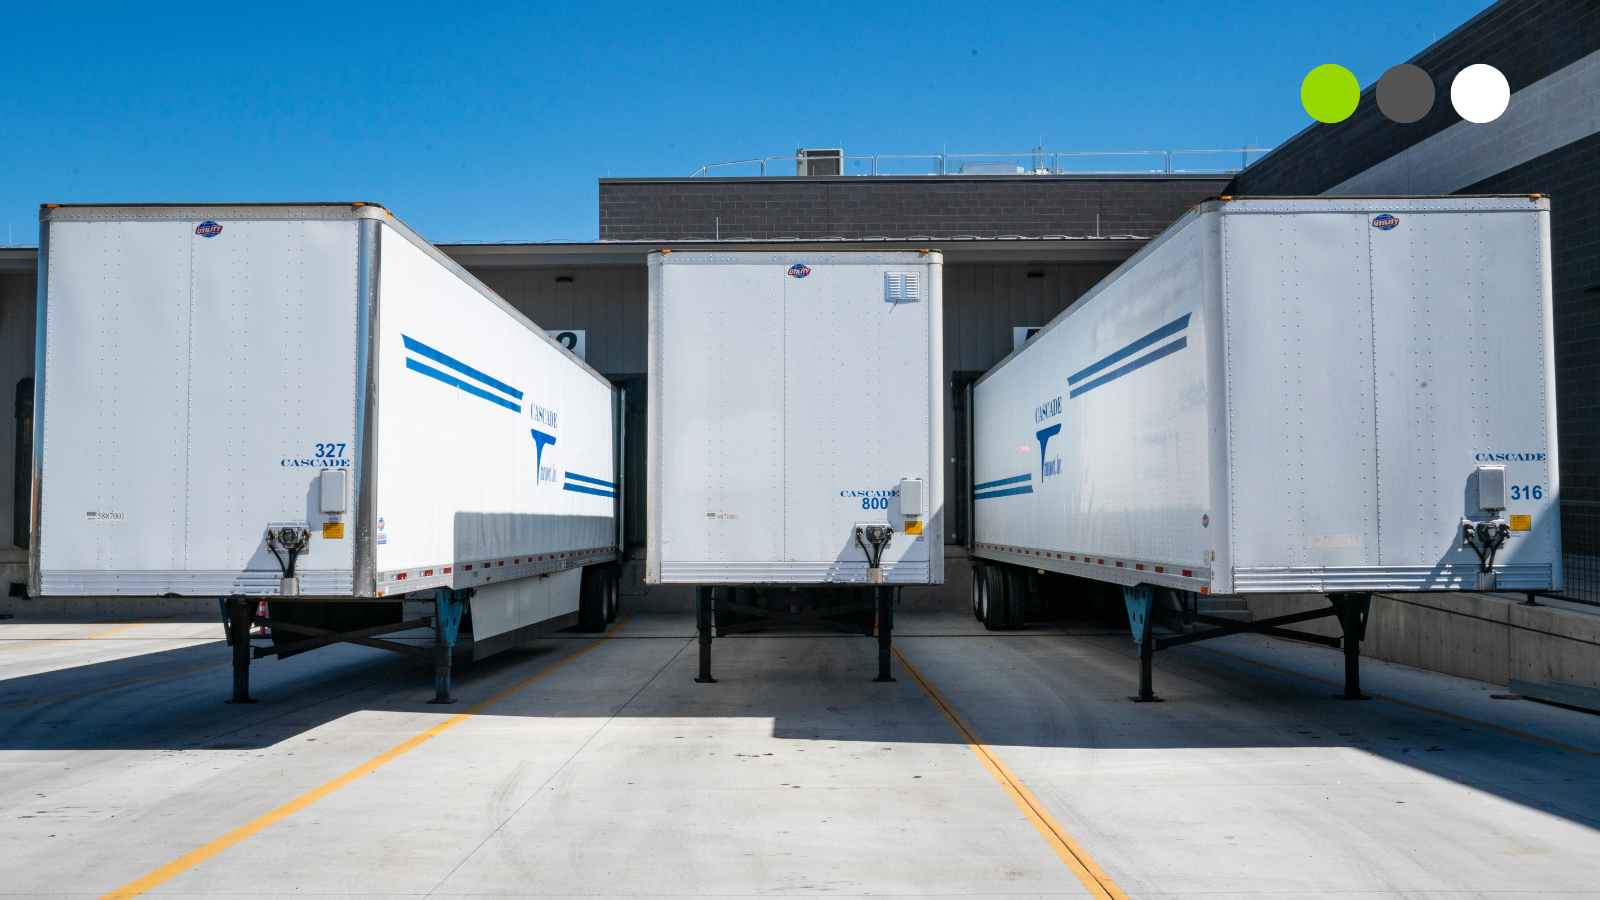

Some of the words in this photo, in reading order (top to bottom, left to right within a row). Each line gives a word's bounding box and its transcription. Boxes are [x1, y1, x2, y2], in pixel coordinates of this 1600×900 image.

[196, 226, 222, 235] UTILITY
[530, 402, 557, 429] CASCADE
[1035, 396, 1062, 424] CASCADE
[315, 443, 346, 458] 327
[280, 459, 350, 467] CASCADE
[1475, 453, 1546, 462] CASCADE
[840, 490, 900, 498] CASCADE
[1511, 485, 1543, 500] 316
[862, 497, 889, 510] 800
